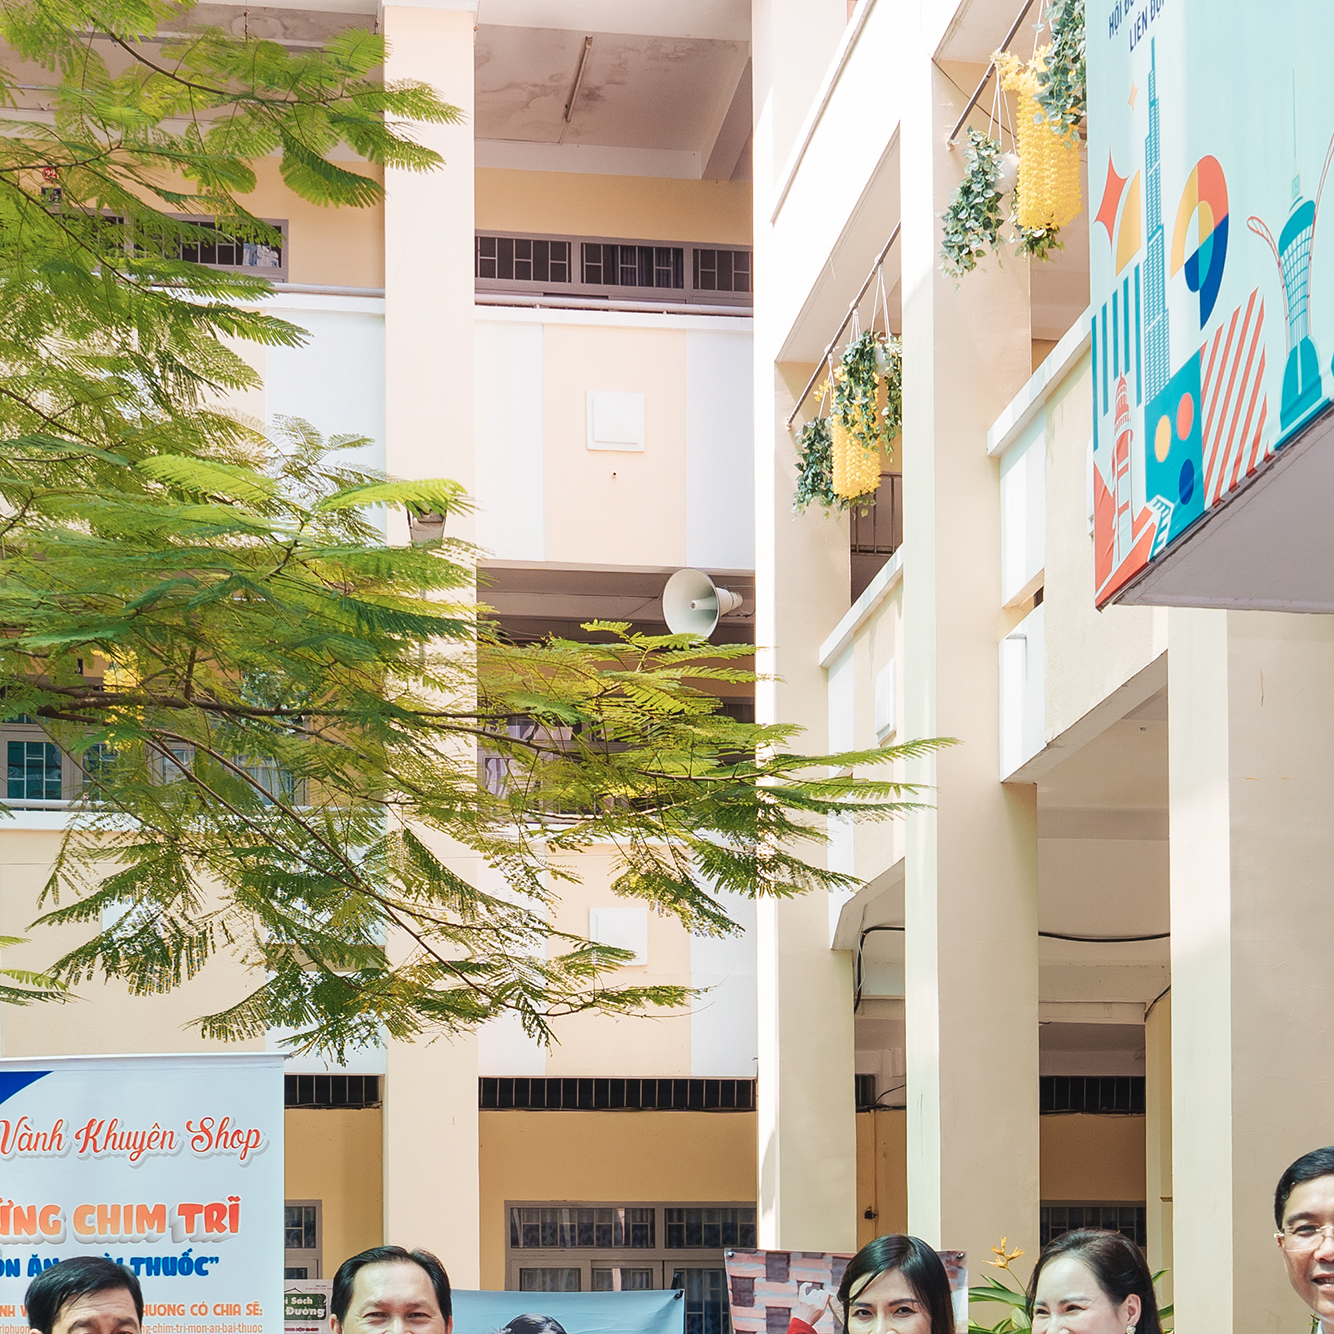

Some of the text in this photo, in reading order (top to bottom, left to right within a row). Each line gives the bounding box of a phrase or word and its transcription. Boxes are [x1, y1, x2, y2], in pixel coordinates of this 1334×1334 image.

[74, 1118, 179, 1162] Khuyên
[186, 1116, 264, 1161] Shop
[72, 1203, 167, 1236] CHIM
[178, 1195, 241, 1235] TRĨ
[190, 1301, 208, 1317] CÓ
[212, 1303, 242, 1317] CHIA
